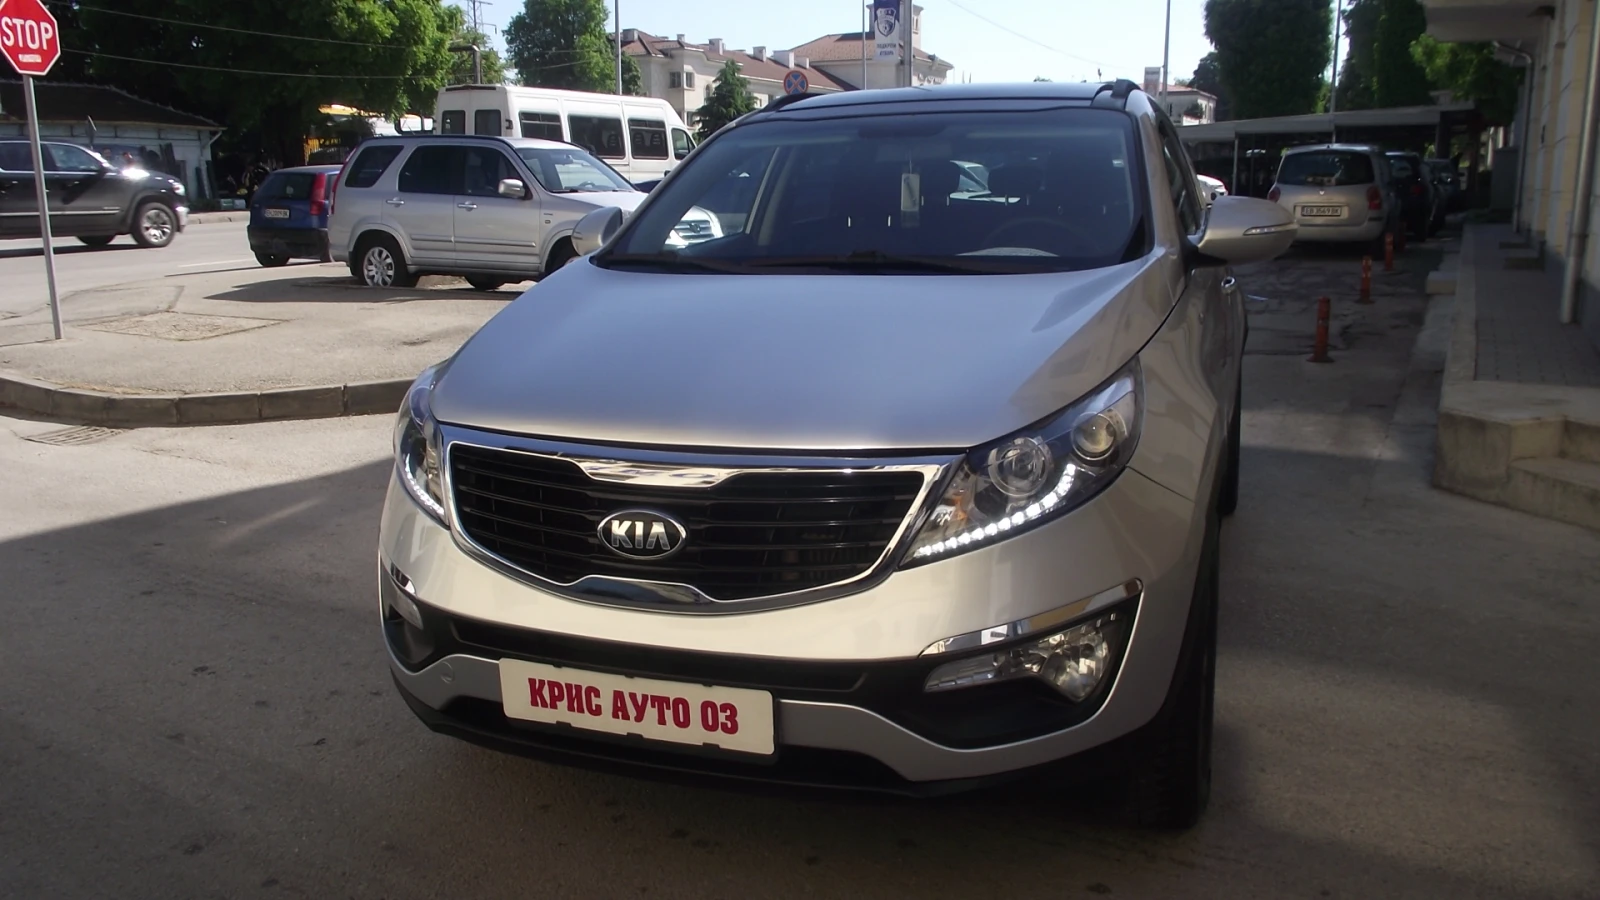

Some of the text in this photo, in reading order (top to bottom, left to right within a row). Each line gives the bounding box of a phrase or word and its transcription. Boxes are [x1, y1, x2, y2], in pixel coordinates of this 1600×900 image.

[1, 16, 53, 50] STOP
[611, 520, 671, 550] KIA
[527, 677, 739, 735] КРИС АУТО 03
